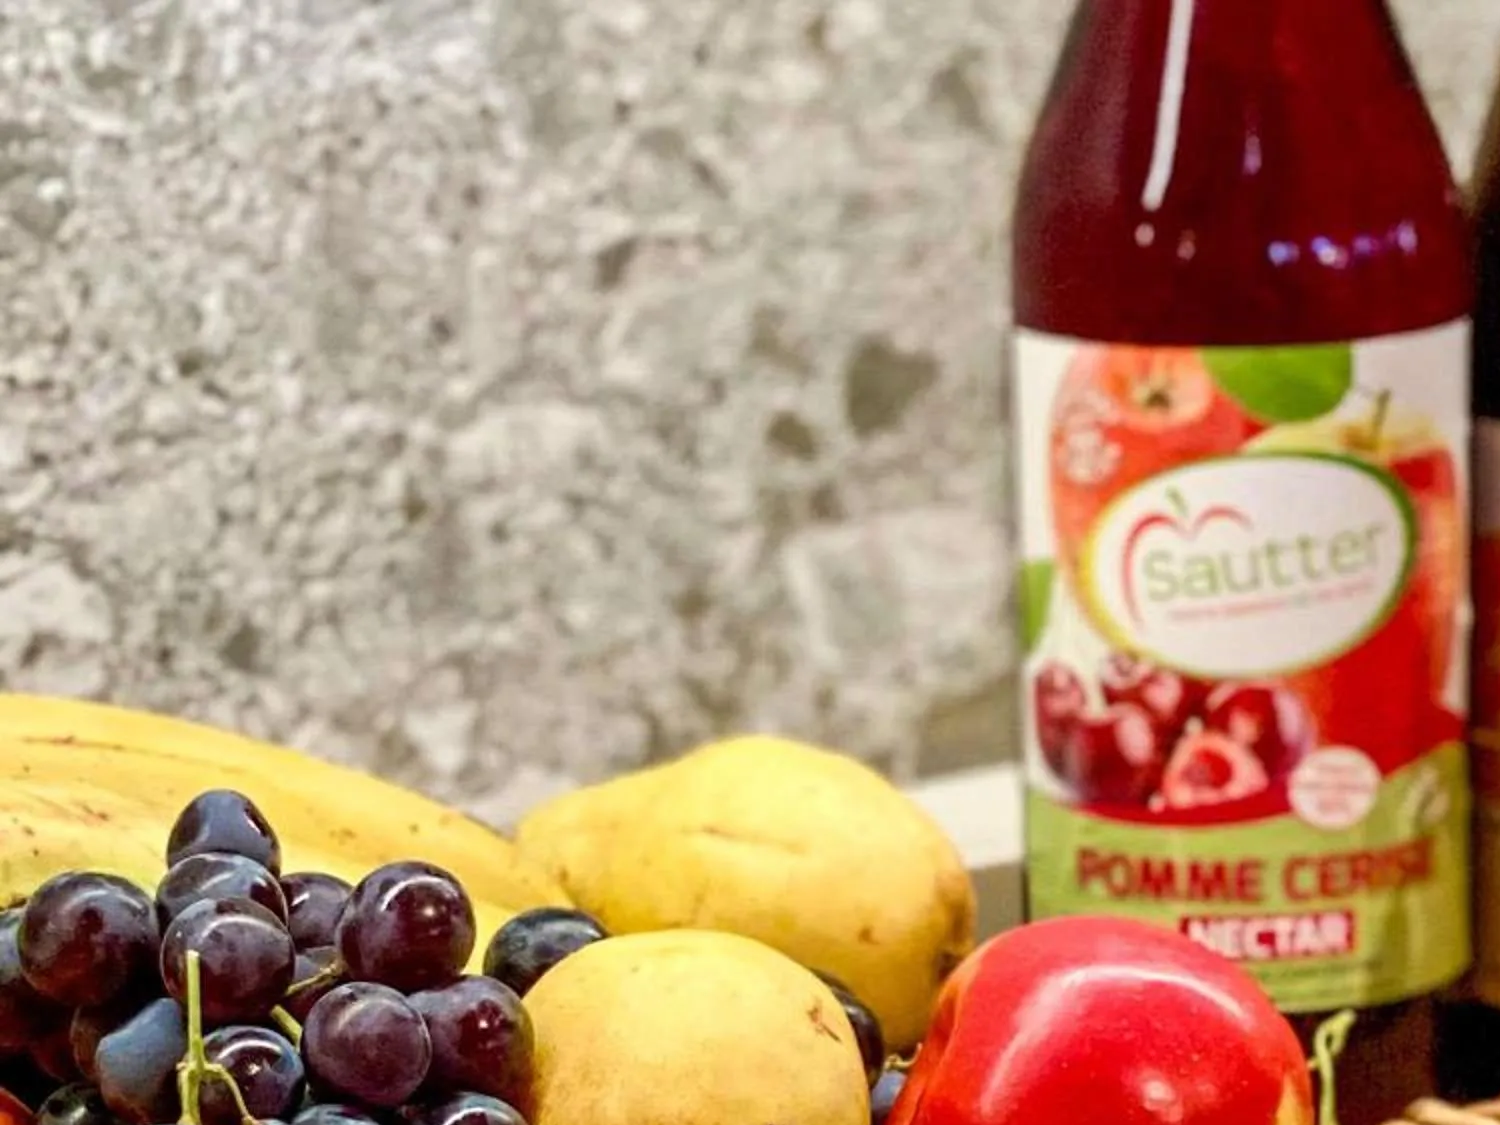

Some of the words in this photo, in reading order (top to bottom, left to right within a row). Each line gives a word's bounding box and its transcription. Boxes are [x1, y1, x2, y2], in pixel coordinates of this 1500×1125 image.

[1142, 521, 1387, 602] Sautter
[1077, 847, 1262, 903] POMME
[1188, 912, 1347, 958] NECTAR
